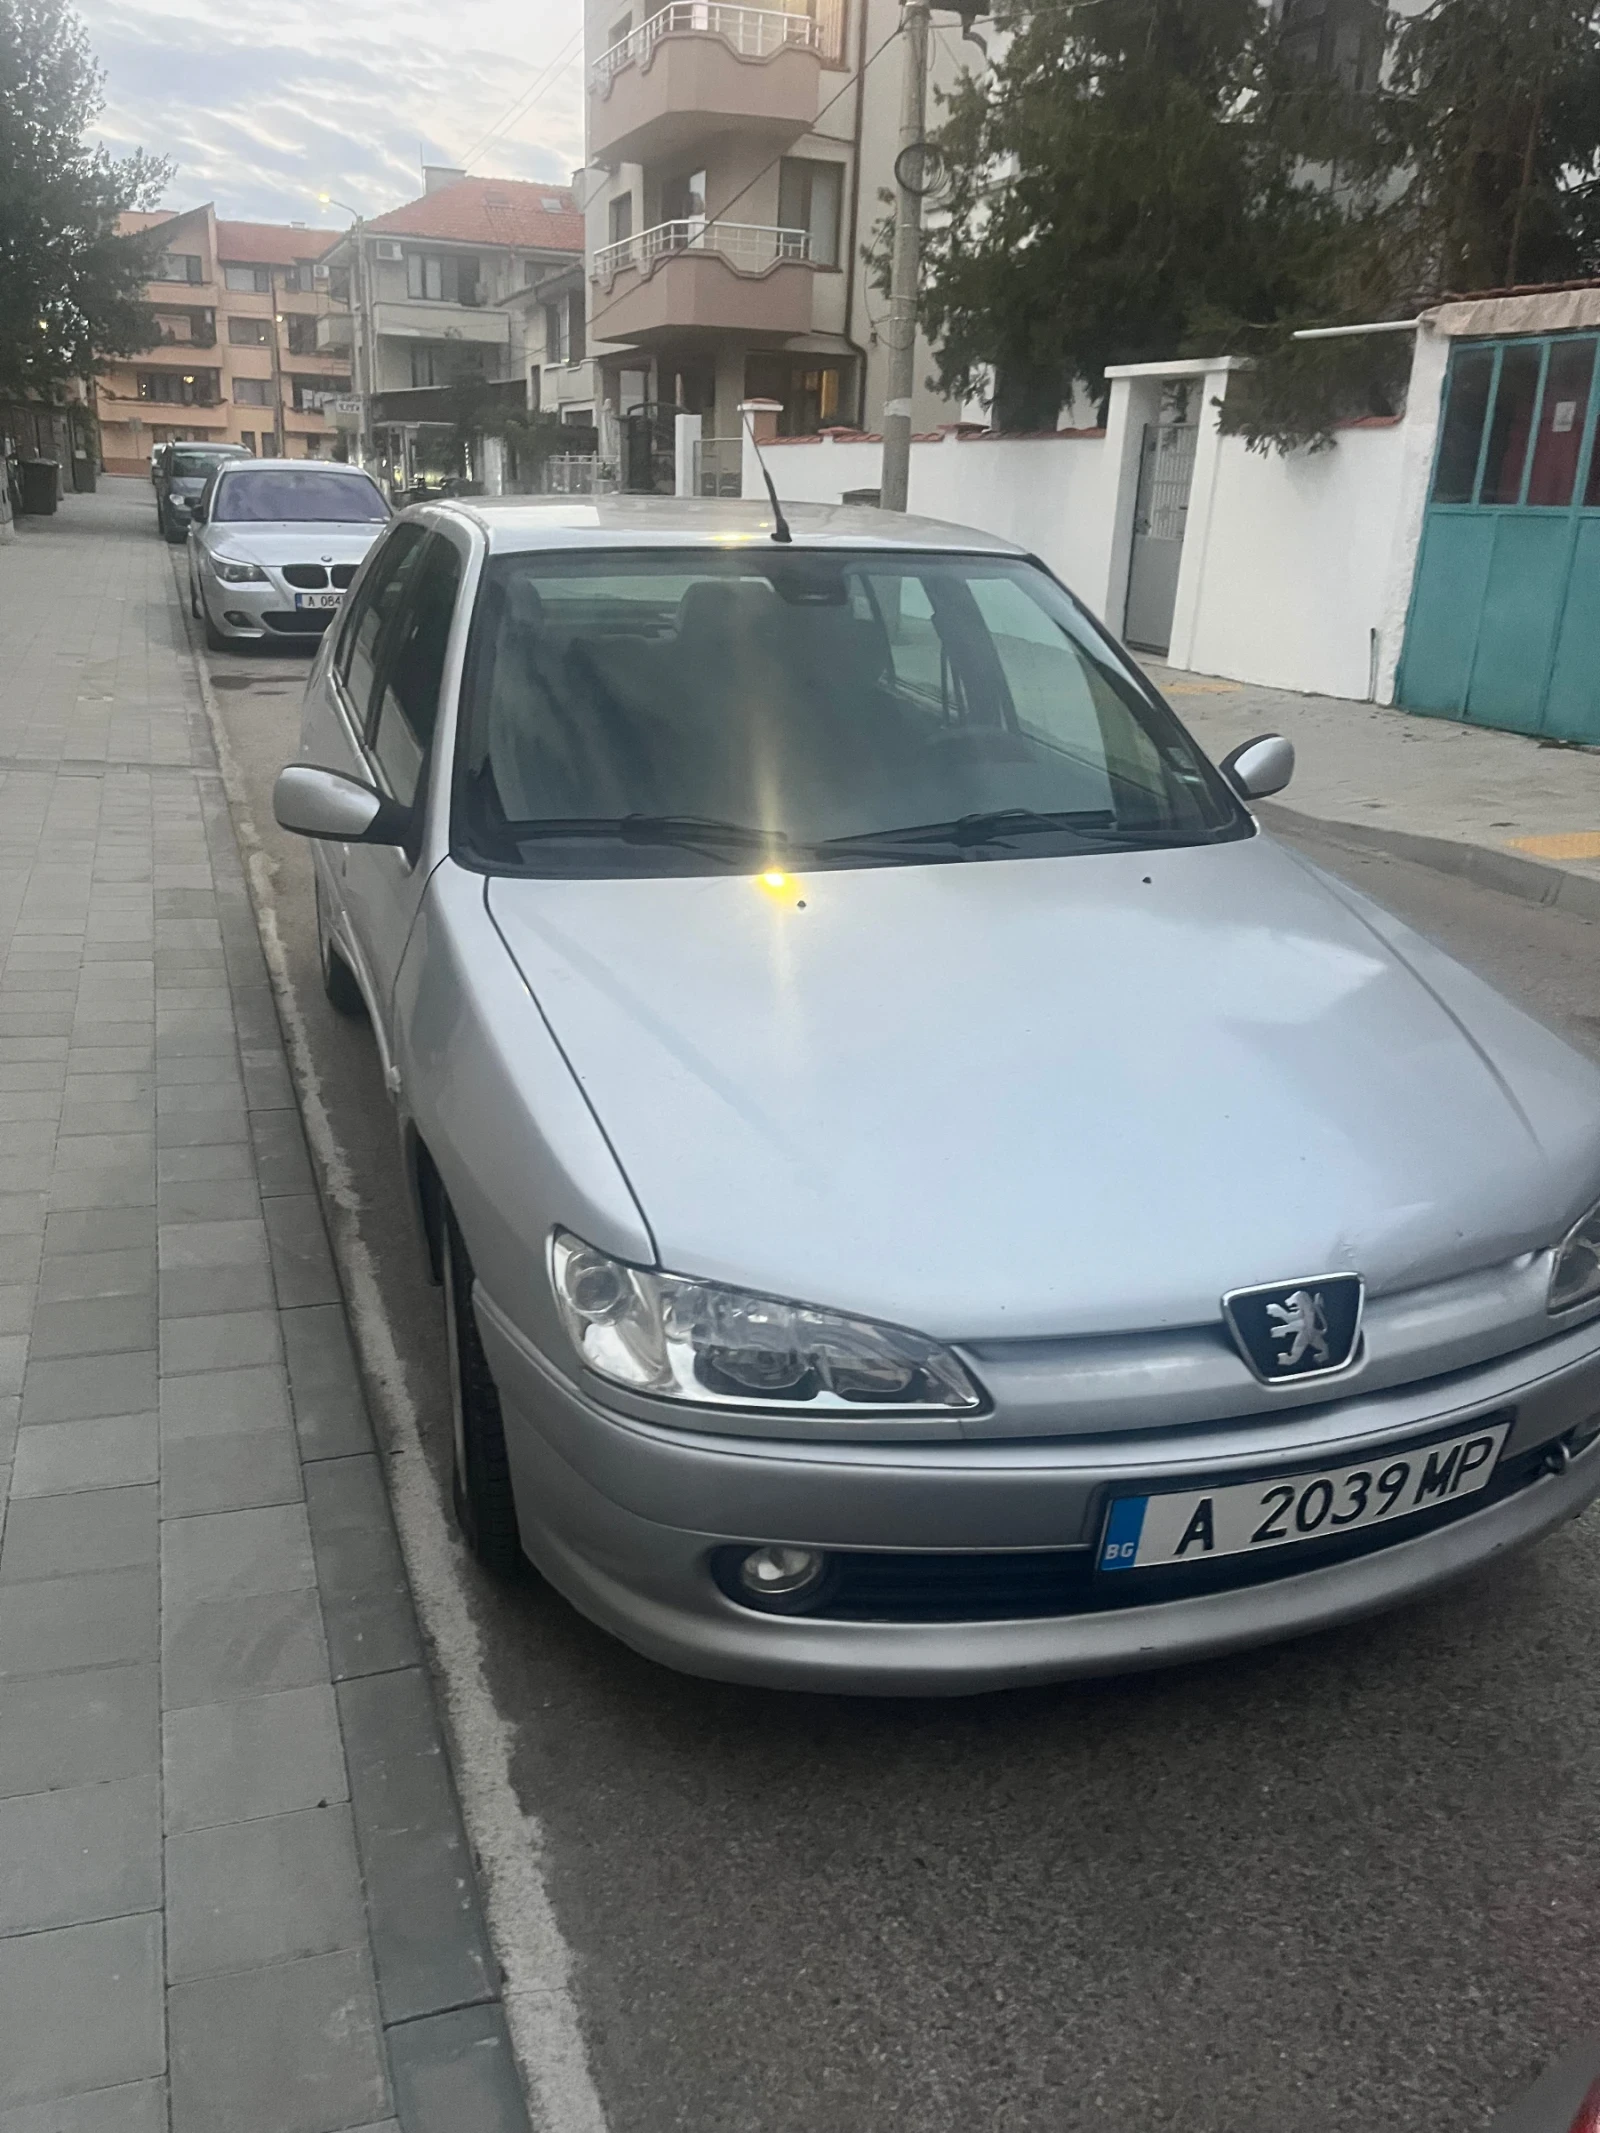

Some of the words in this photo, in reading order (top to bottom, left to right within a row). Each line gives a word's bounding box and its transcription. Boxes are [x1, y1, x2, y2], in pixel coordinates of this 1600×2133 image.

[308, 595, 315, 607] A
[1173, 1498, 1213, 1555] A
[1250, 1461, 1411, 1543] 2039
[1412, 1436, 1494, 1505] MP
[1105, 1542, 1134, 1560] BG
